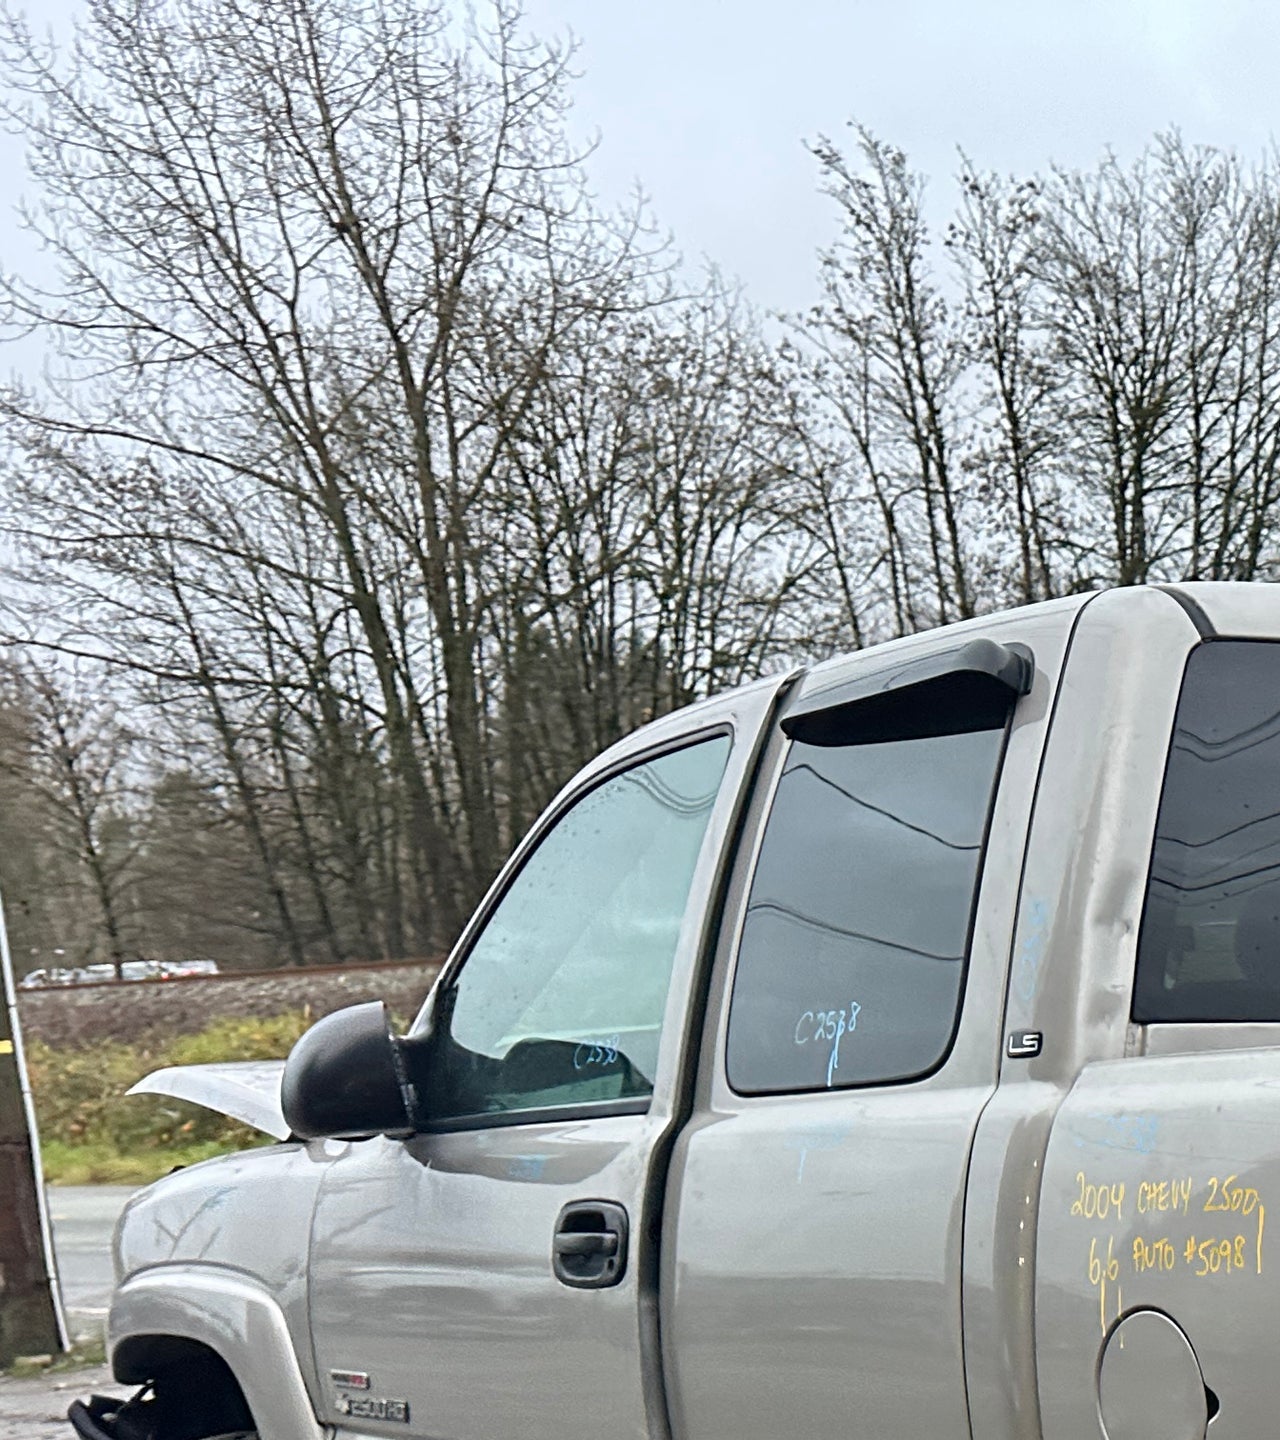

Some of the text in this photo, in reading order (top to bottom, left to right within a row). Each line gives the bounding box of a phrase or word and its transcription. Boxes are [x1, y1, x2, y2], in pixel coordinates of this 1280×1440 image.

[794, 1002, 861, 1044] C2538
[1009, 1034, 1039, 1053] LS
[1071, 1171, 1260, 1220] 2004 CHEVY 2500
[1088, 1235, 1246, 1285] 6.6 AUTO #5098
